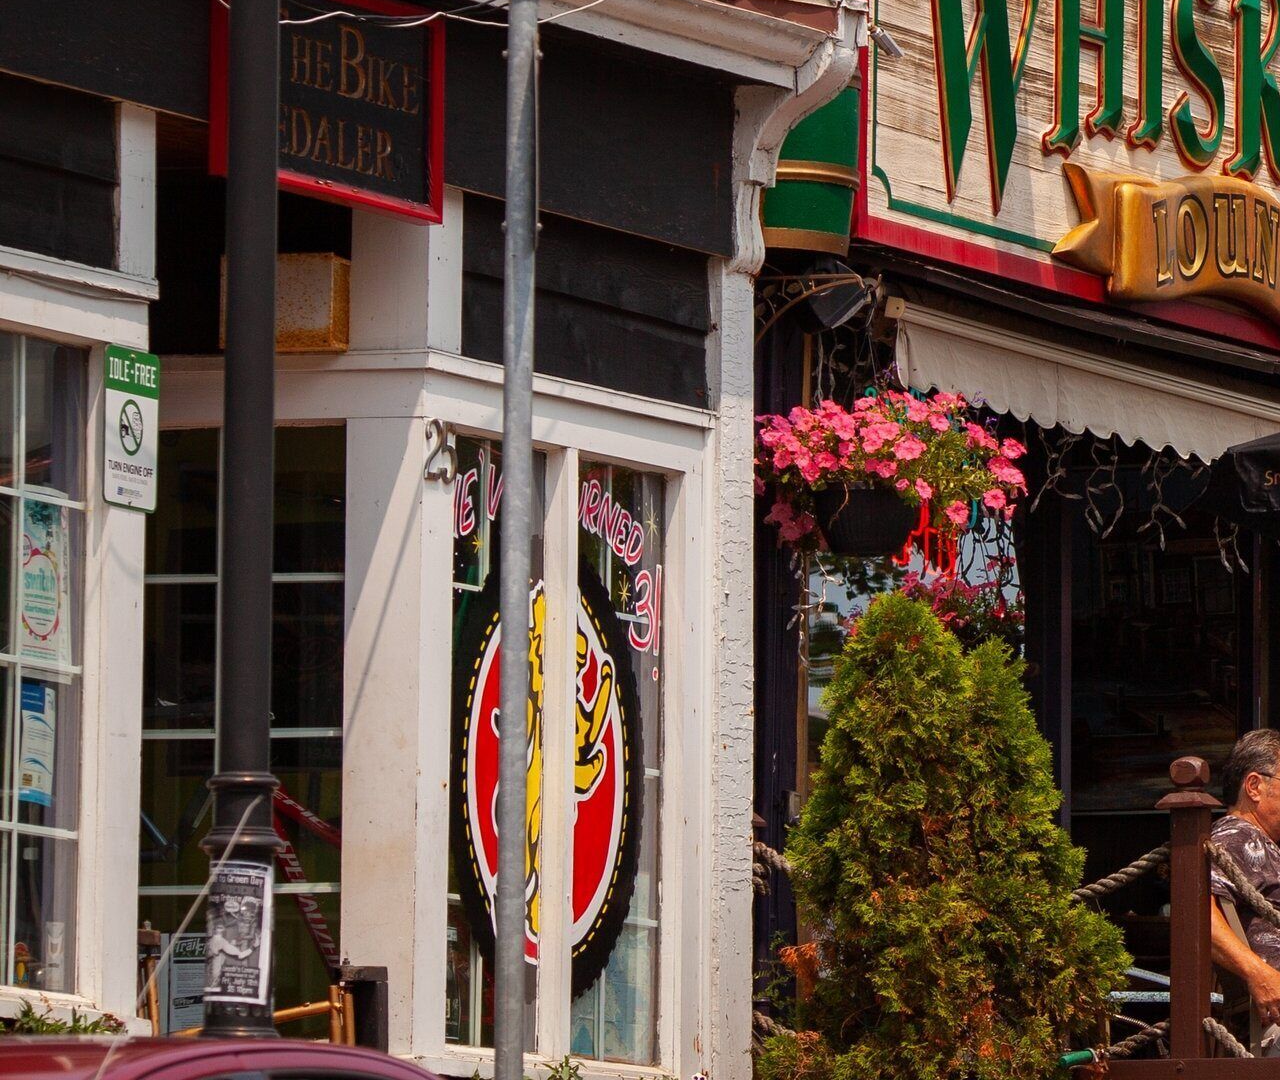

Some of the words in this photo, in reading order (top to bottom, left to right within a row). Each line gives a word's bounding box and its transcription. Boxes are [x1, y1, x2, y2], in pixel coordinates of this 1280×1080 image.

[337, 24, 419, 116] BIKE
[109, 357, 157, 389] IDLE-FREE
[108, 459, 122, 471] TURN
[123, 463, 142, 475] ENGINE
[143, 467, 154, 478] OFF
[424, 418, 458, 485] 25
